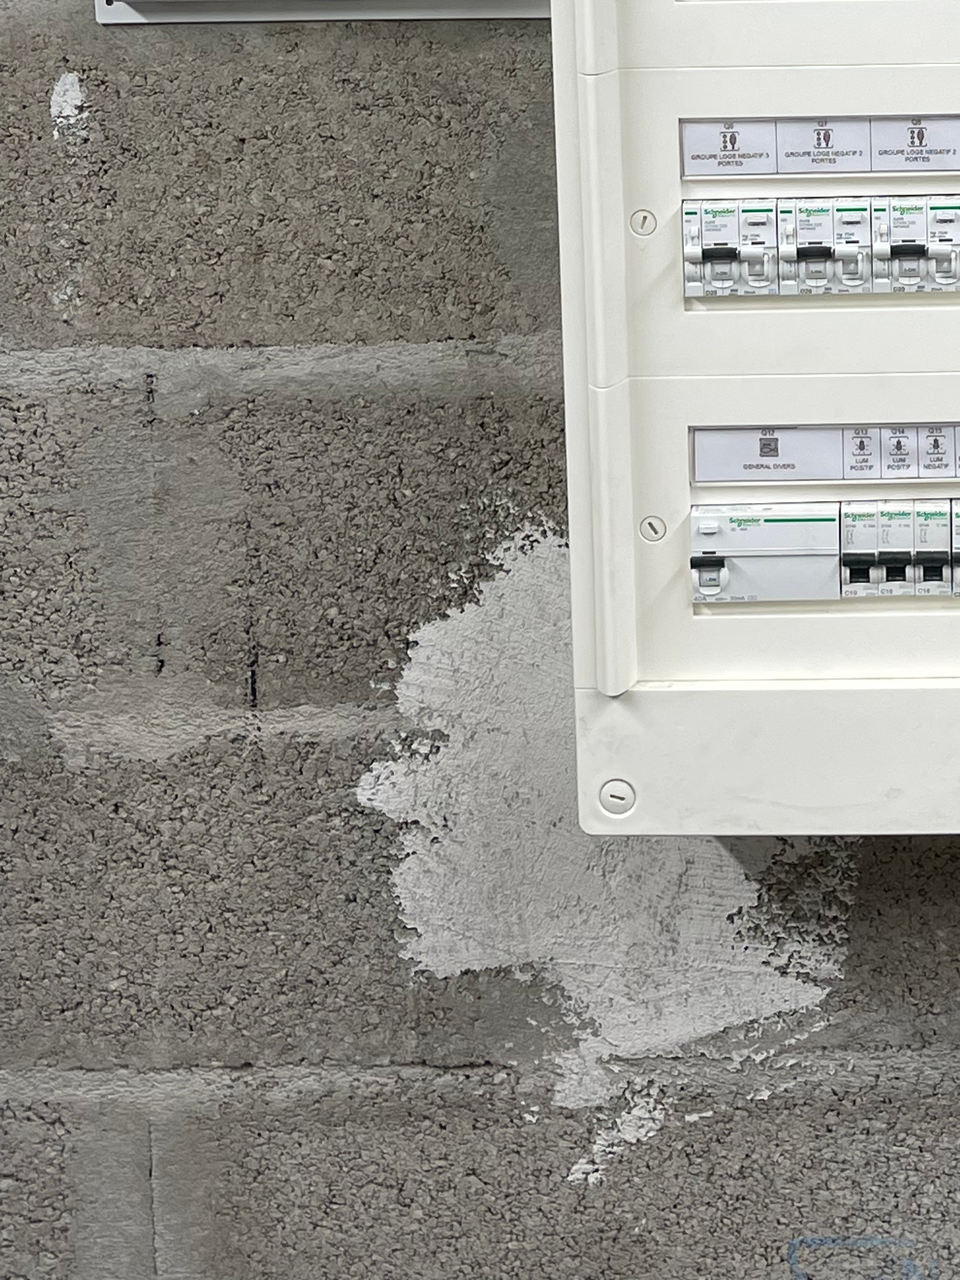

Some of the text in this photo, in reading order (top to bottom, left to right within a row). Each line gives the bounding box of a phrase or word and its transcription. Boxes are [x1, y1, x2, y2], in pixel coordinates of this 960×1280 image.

[704, 208, 736, 217] Schneider
[798, 208, 830, 216] Schneider
[892, 206, 924, 214] Schneider
[844, 512, 876, 521] Schneider
[880, 511, 911, 520] Schneider
[916, 511, 948, 520] Schneider
[729, 517, 761, 526] Schneider
